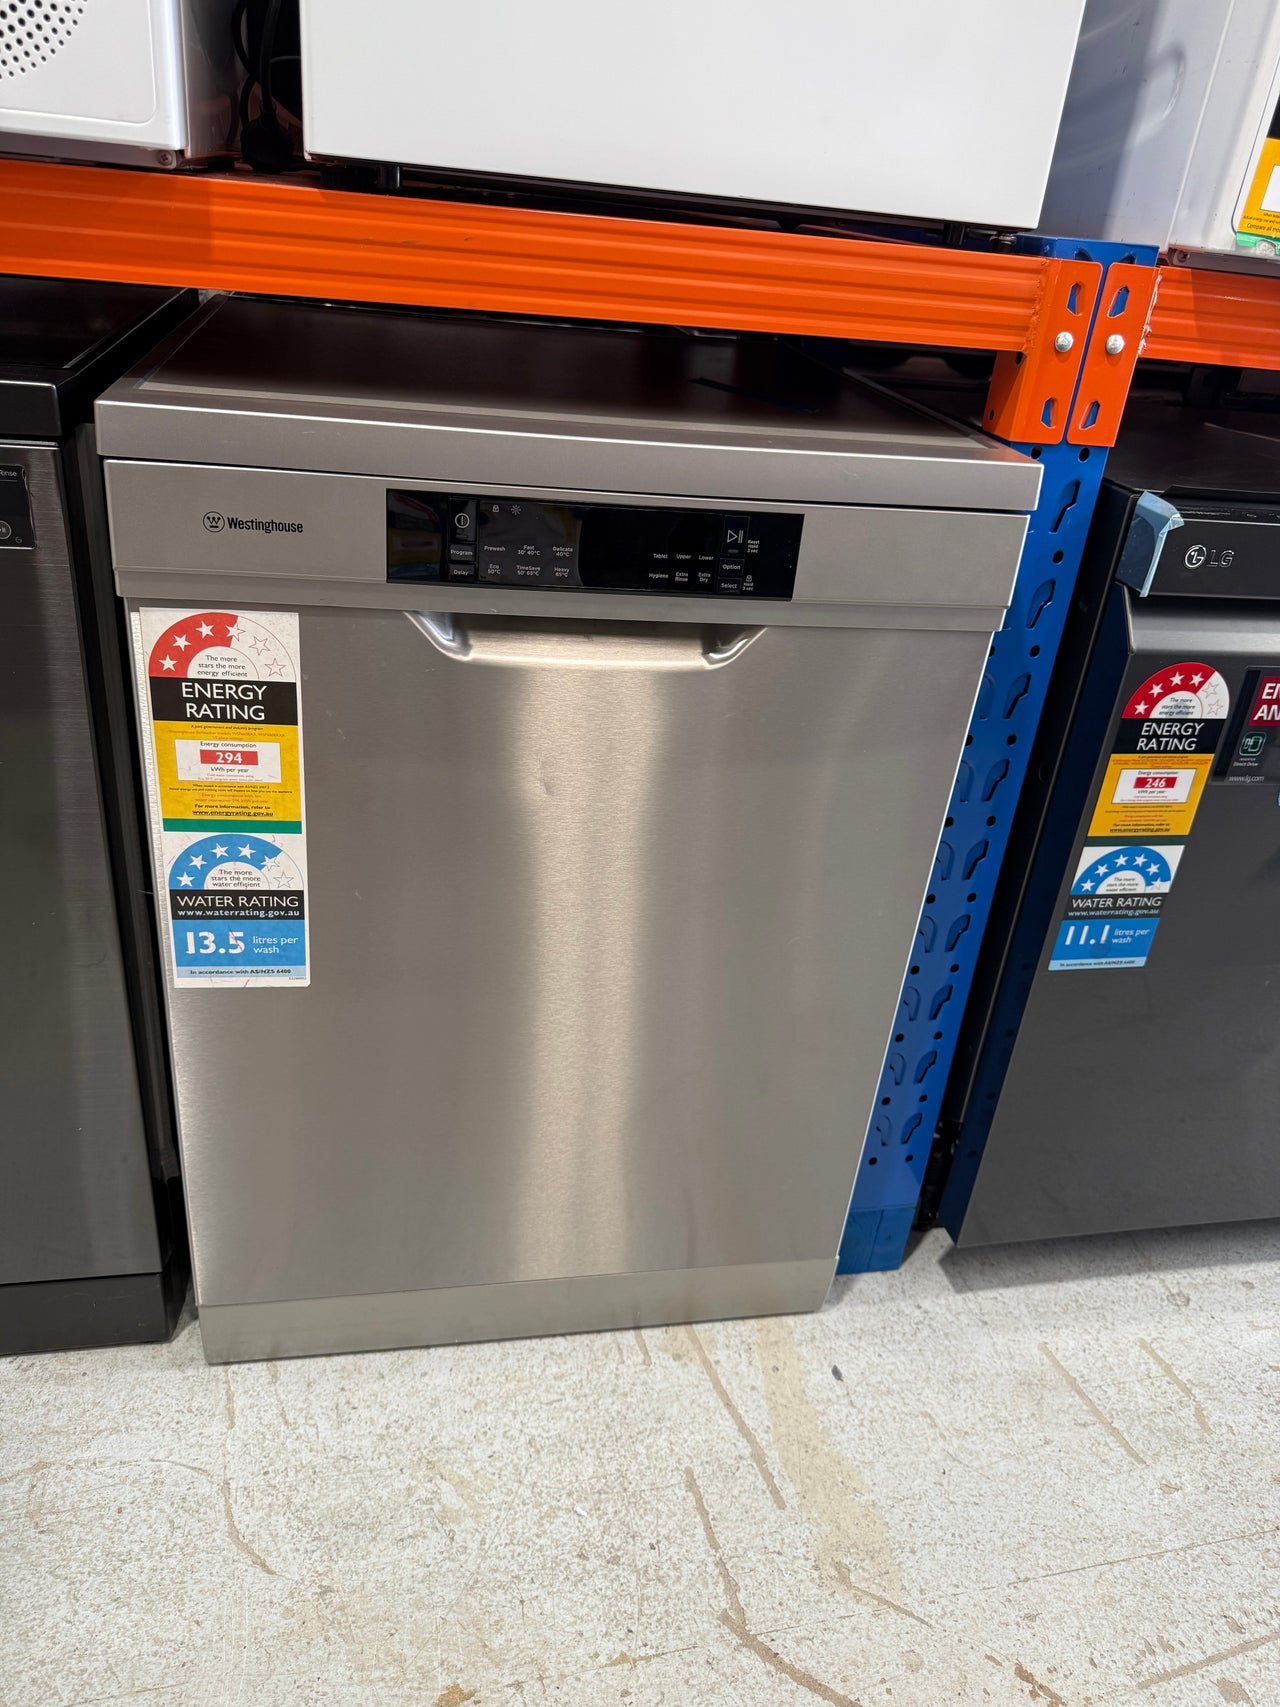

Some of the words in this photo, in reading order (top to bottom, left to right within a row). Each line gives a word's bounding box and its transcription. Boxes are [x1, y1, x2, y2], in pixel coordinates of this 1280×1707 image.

[227, 517, 303, 534] Westinghouse
[1207, 550, 1234, 567] LG
[182, 682, 267, 700] ENERGY
[186, 703, 265, 720] RATING
[1141, 722, 1205, 735] ENERGY
[1136, 738, 1198, 751] RATING
[216, 752, 242, 763] 294
[1145, 778, 1166, 788] 246
[1229, 775, 1265, 783] www.lg.com
[177, 896, 234, 907] WATER
[239, 896, 299, 907] RATING
[1072, 899, 1113, 908] WATER
[1116, 897, 1162, 907] RATING
[178, 910, 300, 918] www.waterrating.gov.au
[253, 936, 278, 944] litres
[280, 937, 298, 945] per
[1065, 925, 1110, 945] 11.1
[186, 932, 245, 954] 13.5
[253, 946, 280, 954] wash
